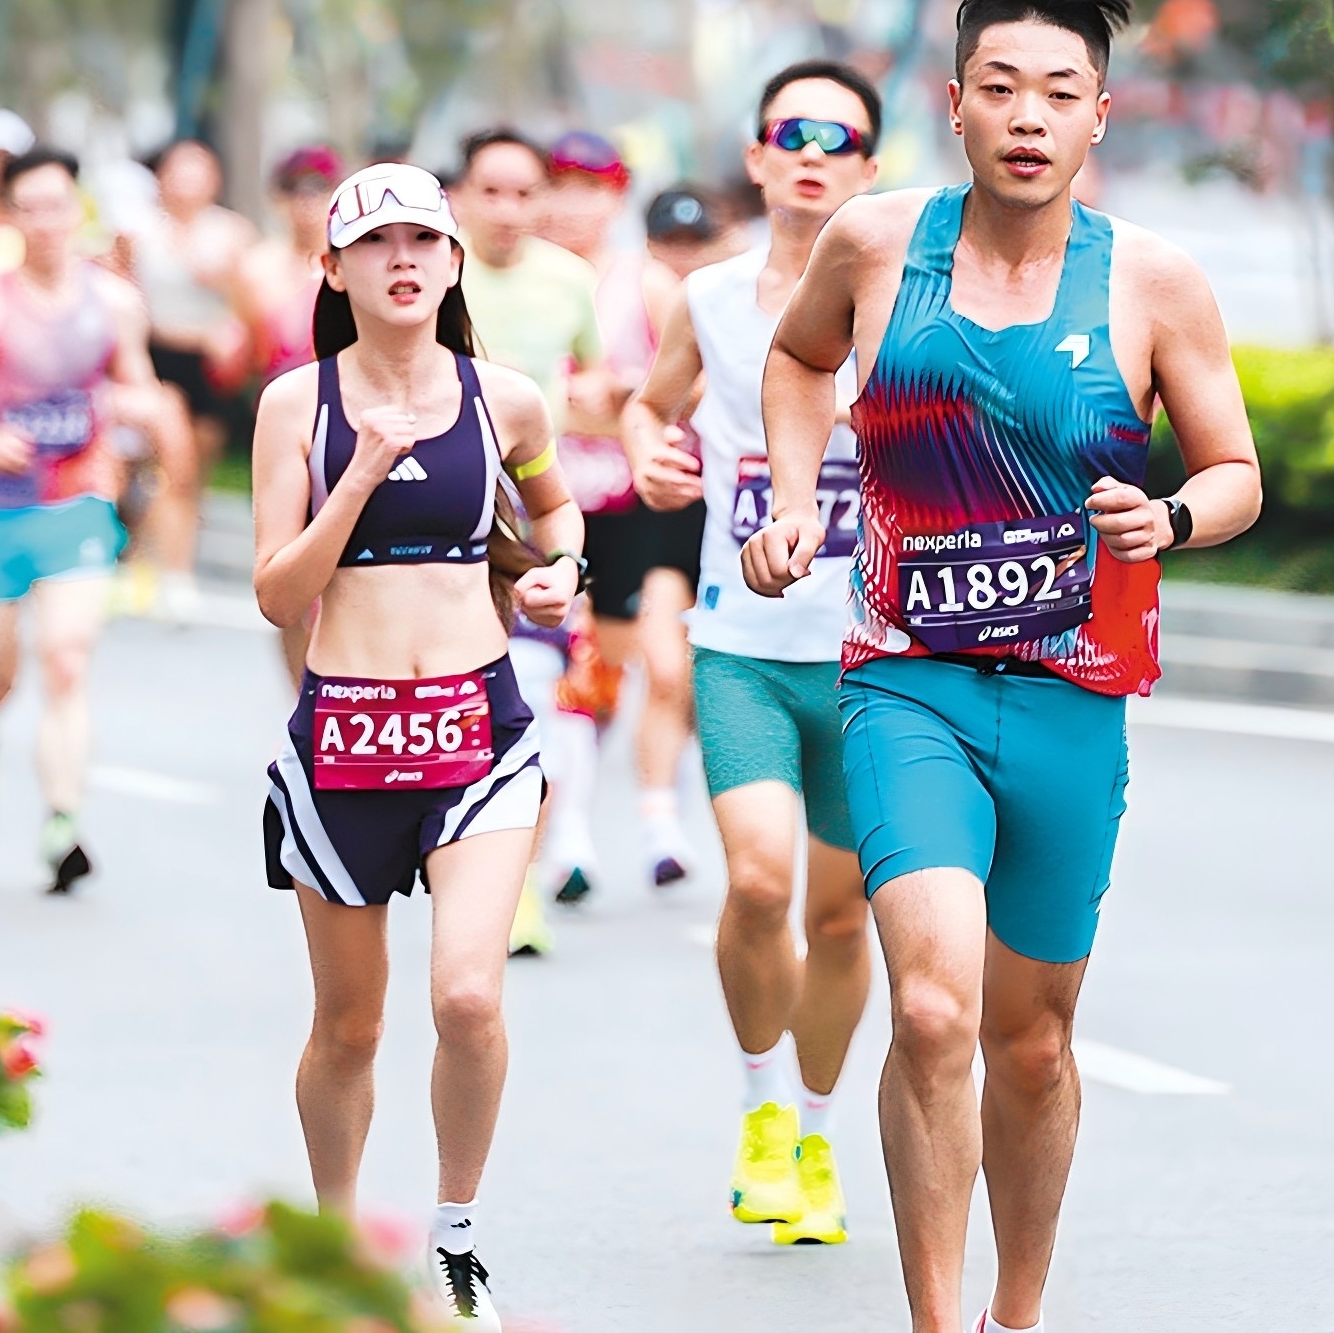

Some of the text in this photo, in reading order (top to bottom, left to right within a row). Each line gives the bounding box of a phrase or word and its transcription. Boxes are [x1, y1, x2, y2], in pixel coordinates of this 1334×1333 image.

[734, 489, 862, 531] A172
[902, 530, 982, 554] nexperia
[906, 555, 1062, 612] A1892
[320, 710, 463, 755] A2456
